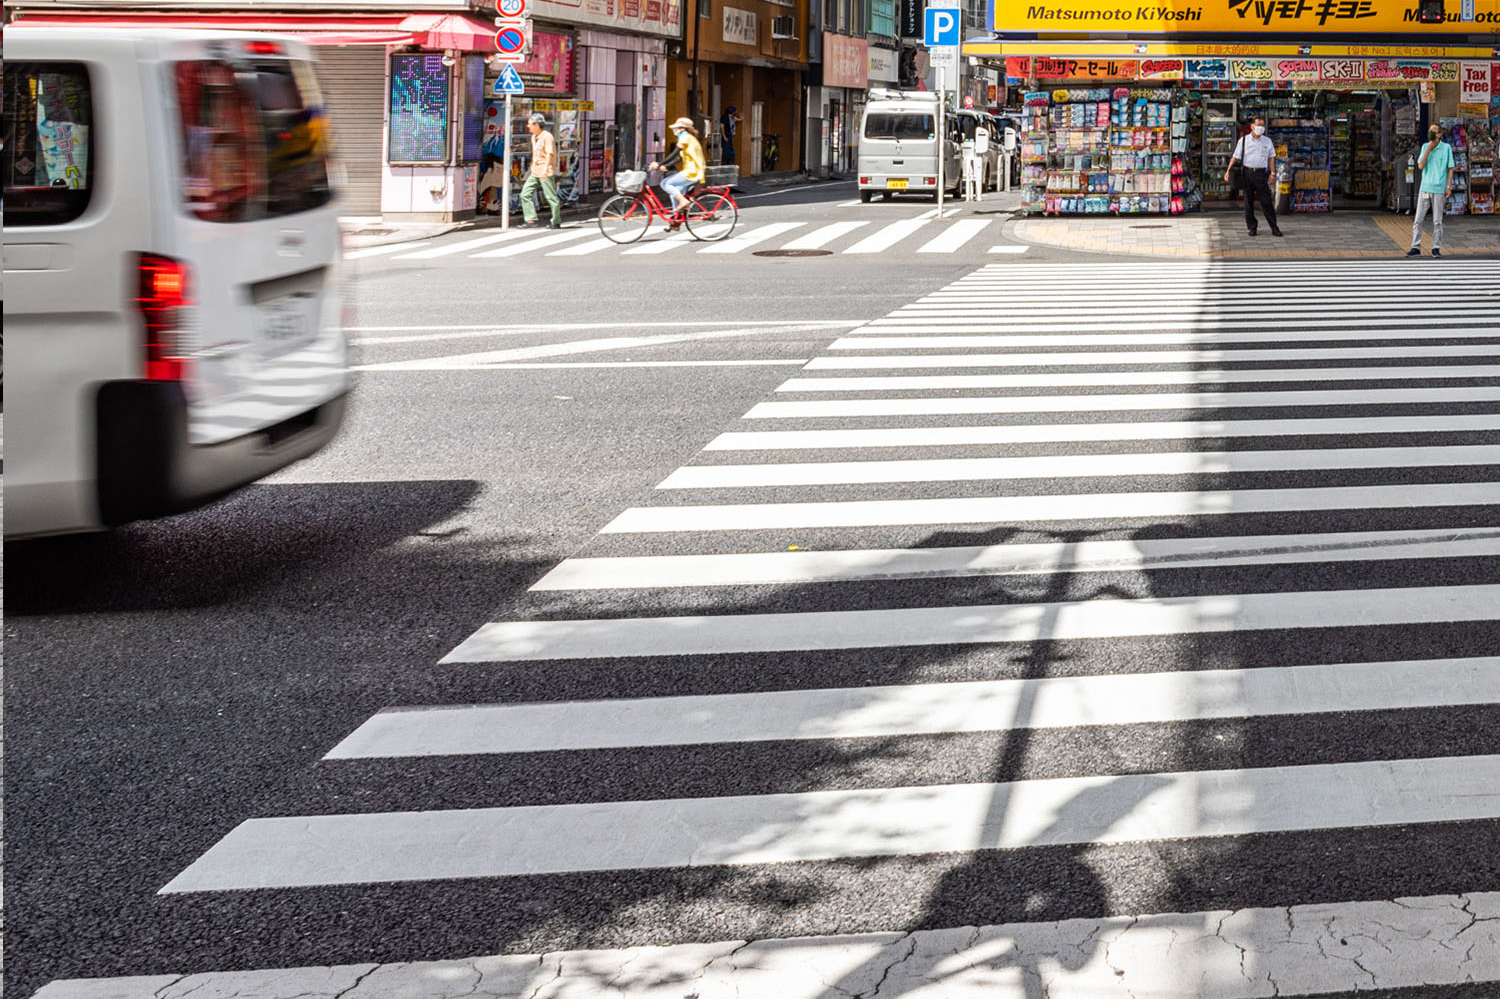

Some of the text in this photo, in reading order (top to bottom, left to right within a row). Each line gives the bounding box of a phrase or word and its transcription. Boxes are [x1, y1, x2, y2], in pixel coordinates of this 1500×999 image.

[503, 0, 520, 11] 20
[1026, 6, 1203, 22] Matsumoto KiYoshi
[933, 11, 954, 43] P
[1466, 68, 1486, 81] Tax
[1463, 81, 1488, 92] Free
